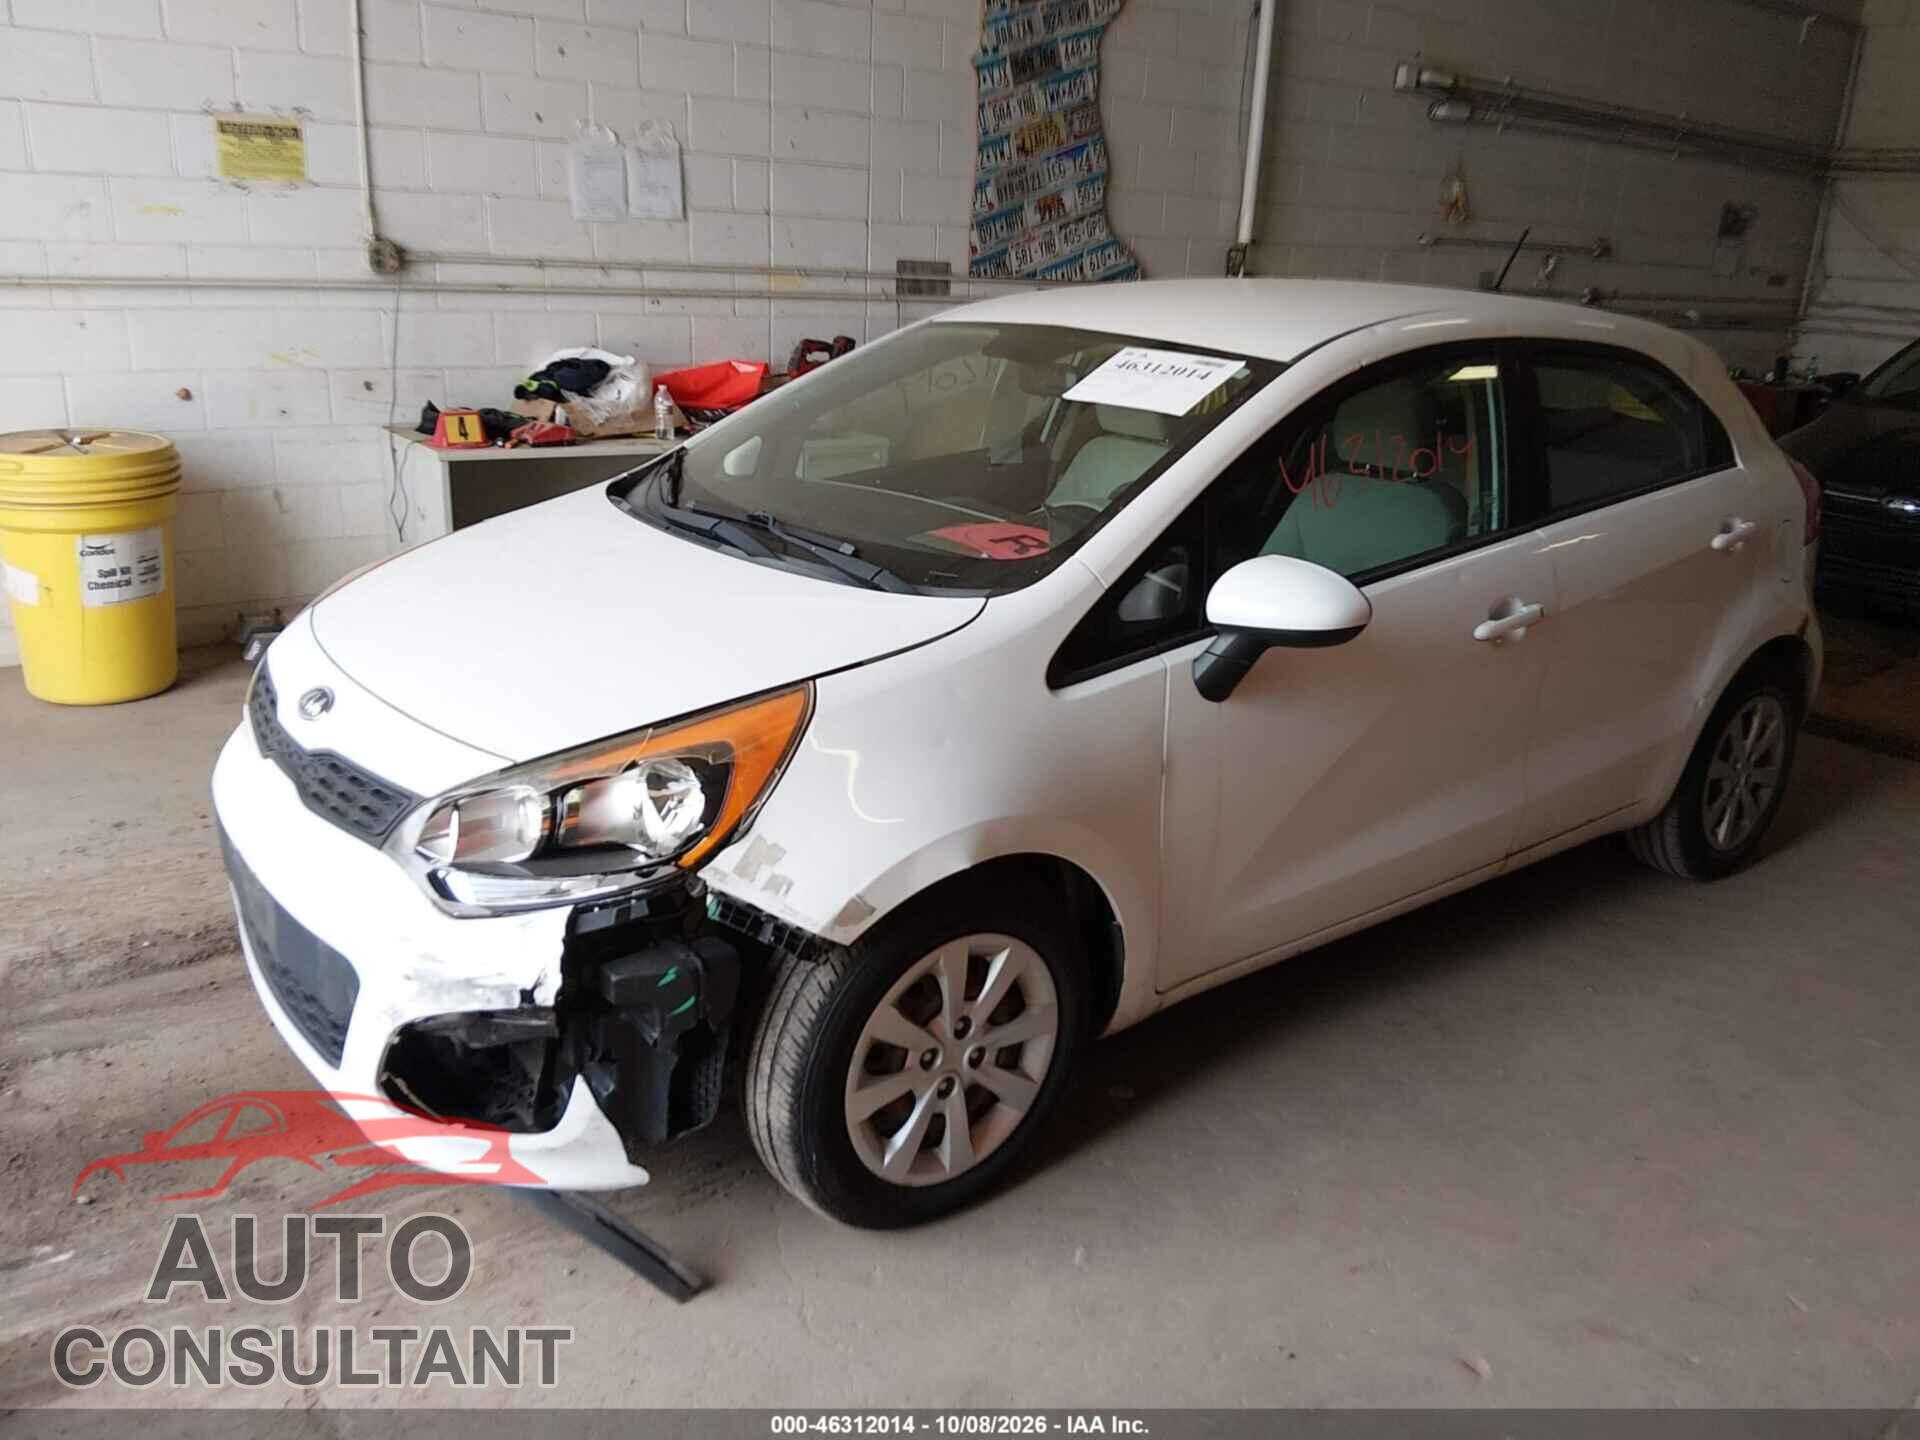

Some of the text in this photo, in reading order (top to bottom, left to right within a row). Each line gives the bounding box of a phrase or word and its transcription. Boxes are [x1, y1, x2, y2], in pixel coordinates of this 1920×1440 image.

[457, 416, 468, 440] 4
[97, 566, 131, 579] Spill Kit
[87, 577, 132, 591] Chemical
